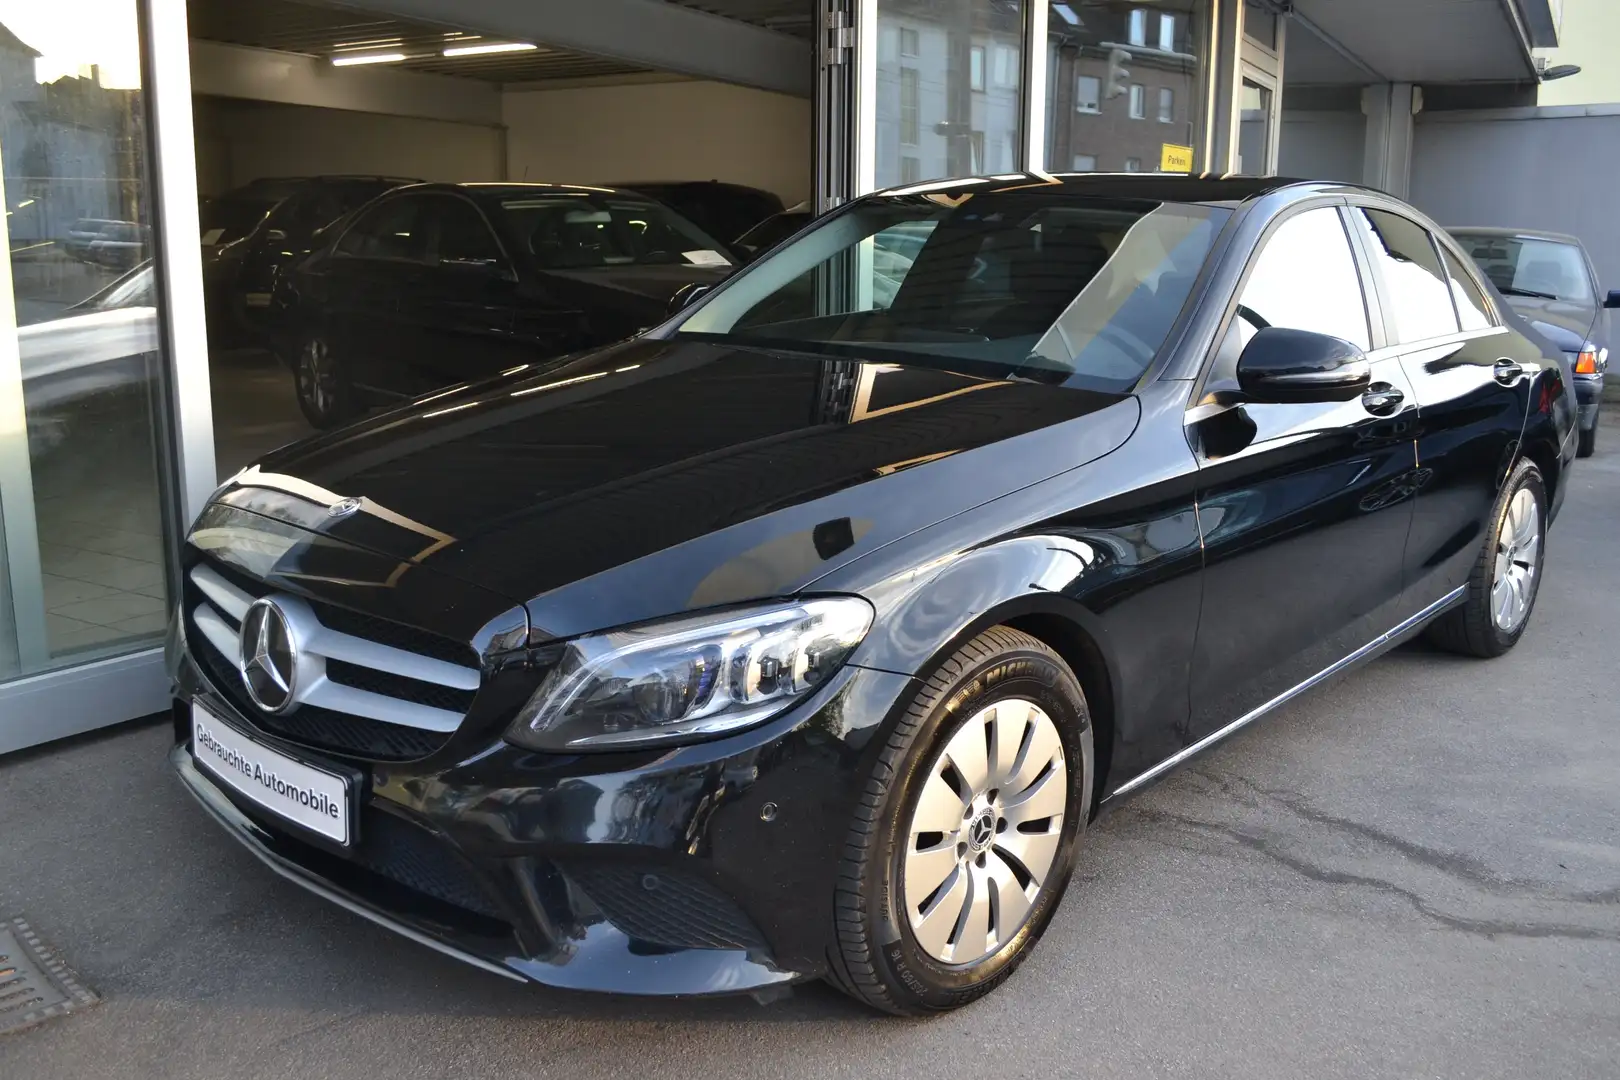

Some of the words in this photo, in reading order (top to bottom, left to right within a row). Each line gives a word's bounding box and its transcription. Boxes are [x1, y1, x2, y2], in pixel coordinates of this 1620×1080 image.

[1167, 155, 1186, 166] Parken
[197, 723, 253, 777] Gebrauchte
[254, 764, 339, 819] Automobile
